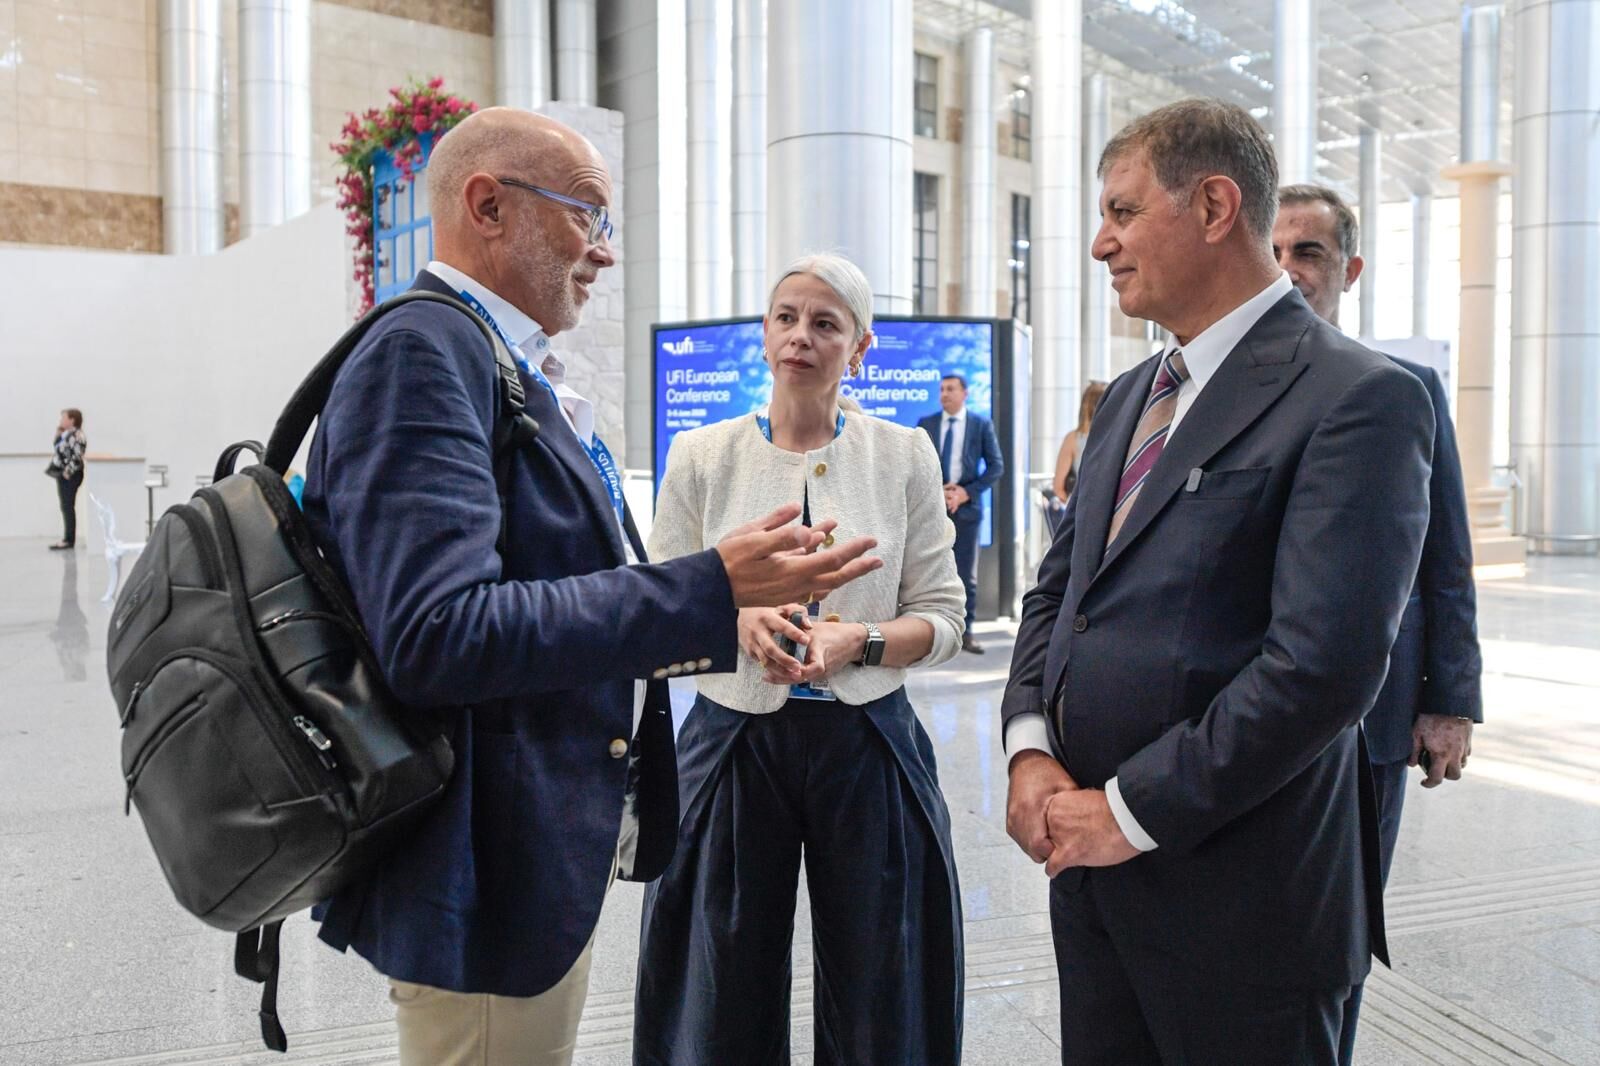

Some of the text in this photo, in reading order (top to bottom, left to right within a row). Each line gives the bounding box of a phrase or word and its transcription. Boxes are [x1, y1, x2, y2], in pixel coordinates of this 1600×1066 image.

[666, 369, 740, 386] UFI European
[868, 365, 941, 384] European
[666, 388, 730, 404] Conference
[840, 384, 929, 401] Conference
